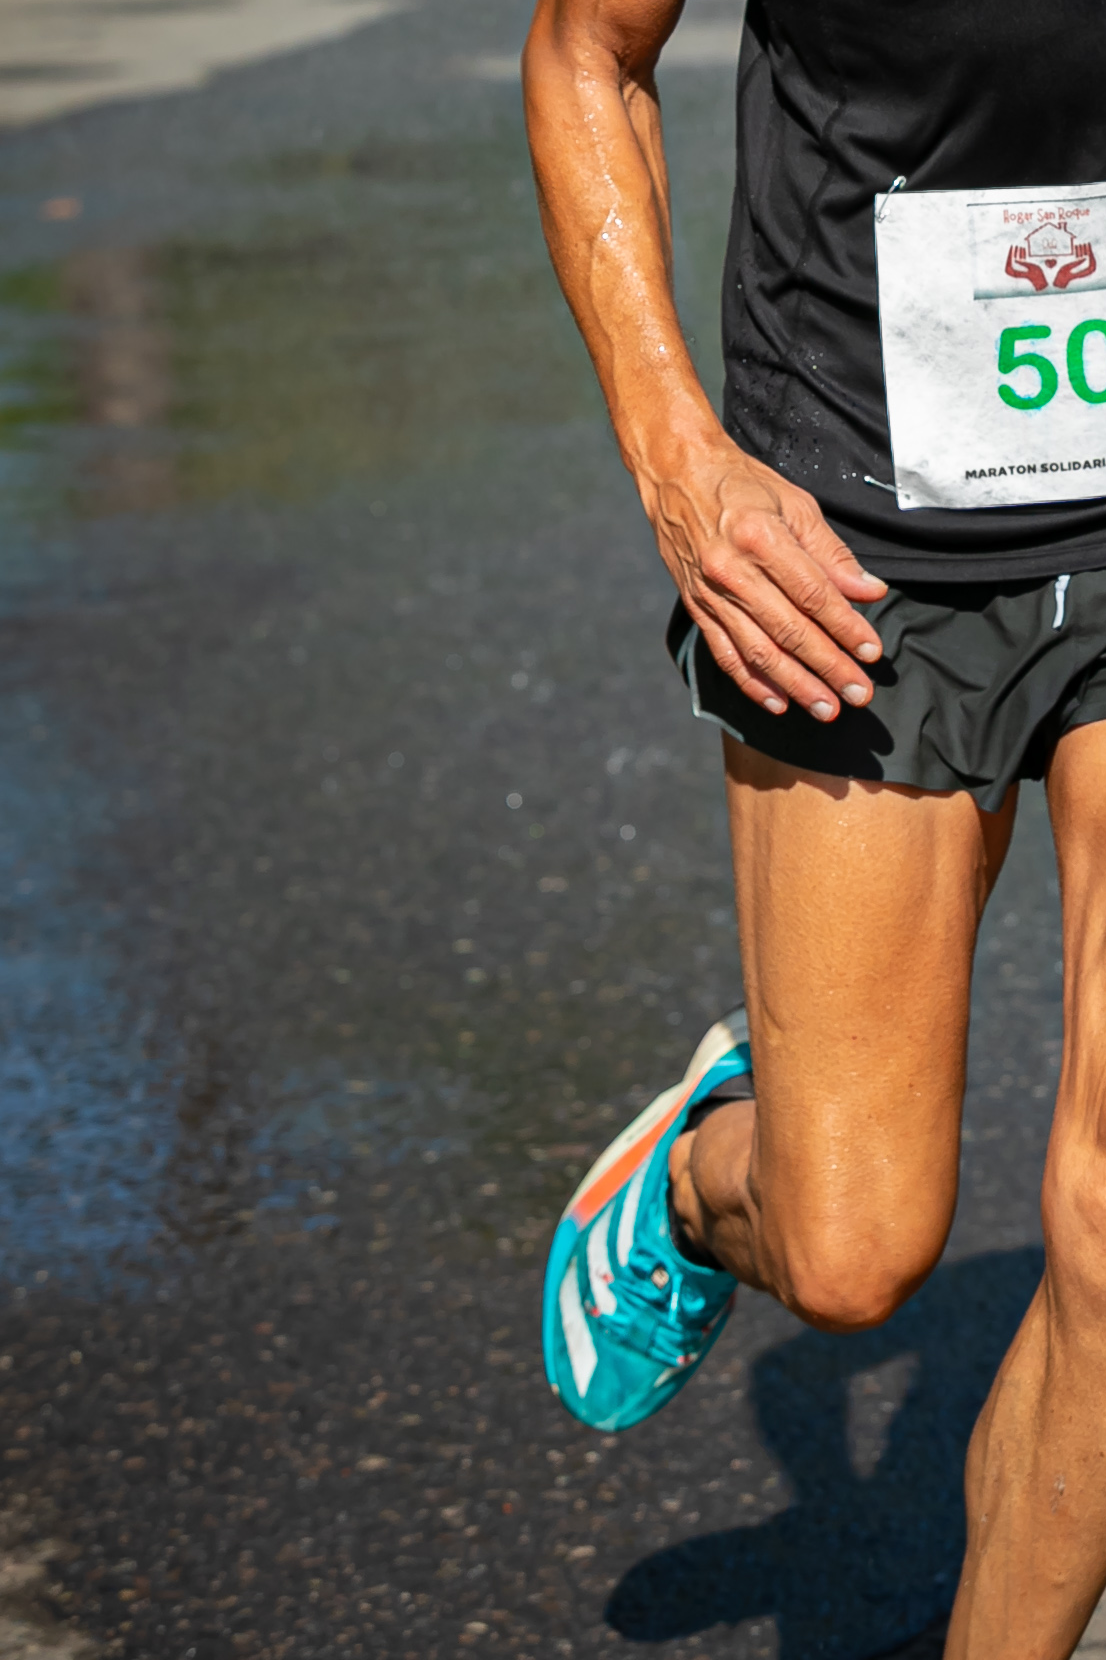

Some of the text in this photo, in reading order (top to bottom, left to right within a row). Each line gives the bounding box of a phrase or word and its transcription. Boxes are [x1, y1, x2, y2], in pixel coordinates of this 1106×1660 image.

[1037, 208, 1056, 222] San
[1058, 207, 1090, 221] Roque
[965, 464, 1037, 480] MARATON
